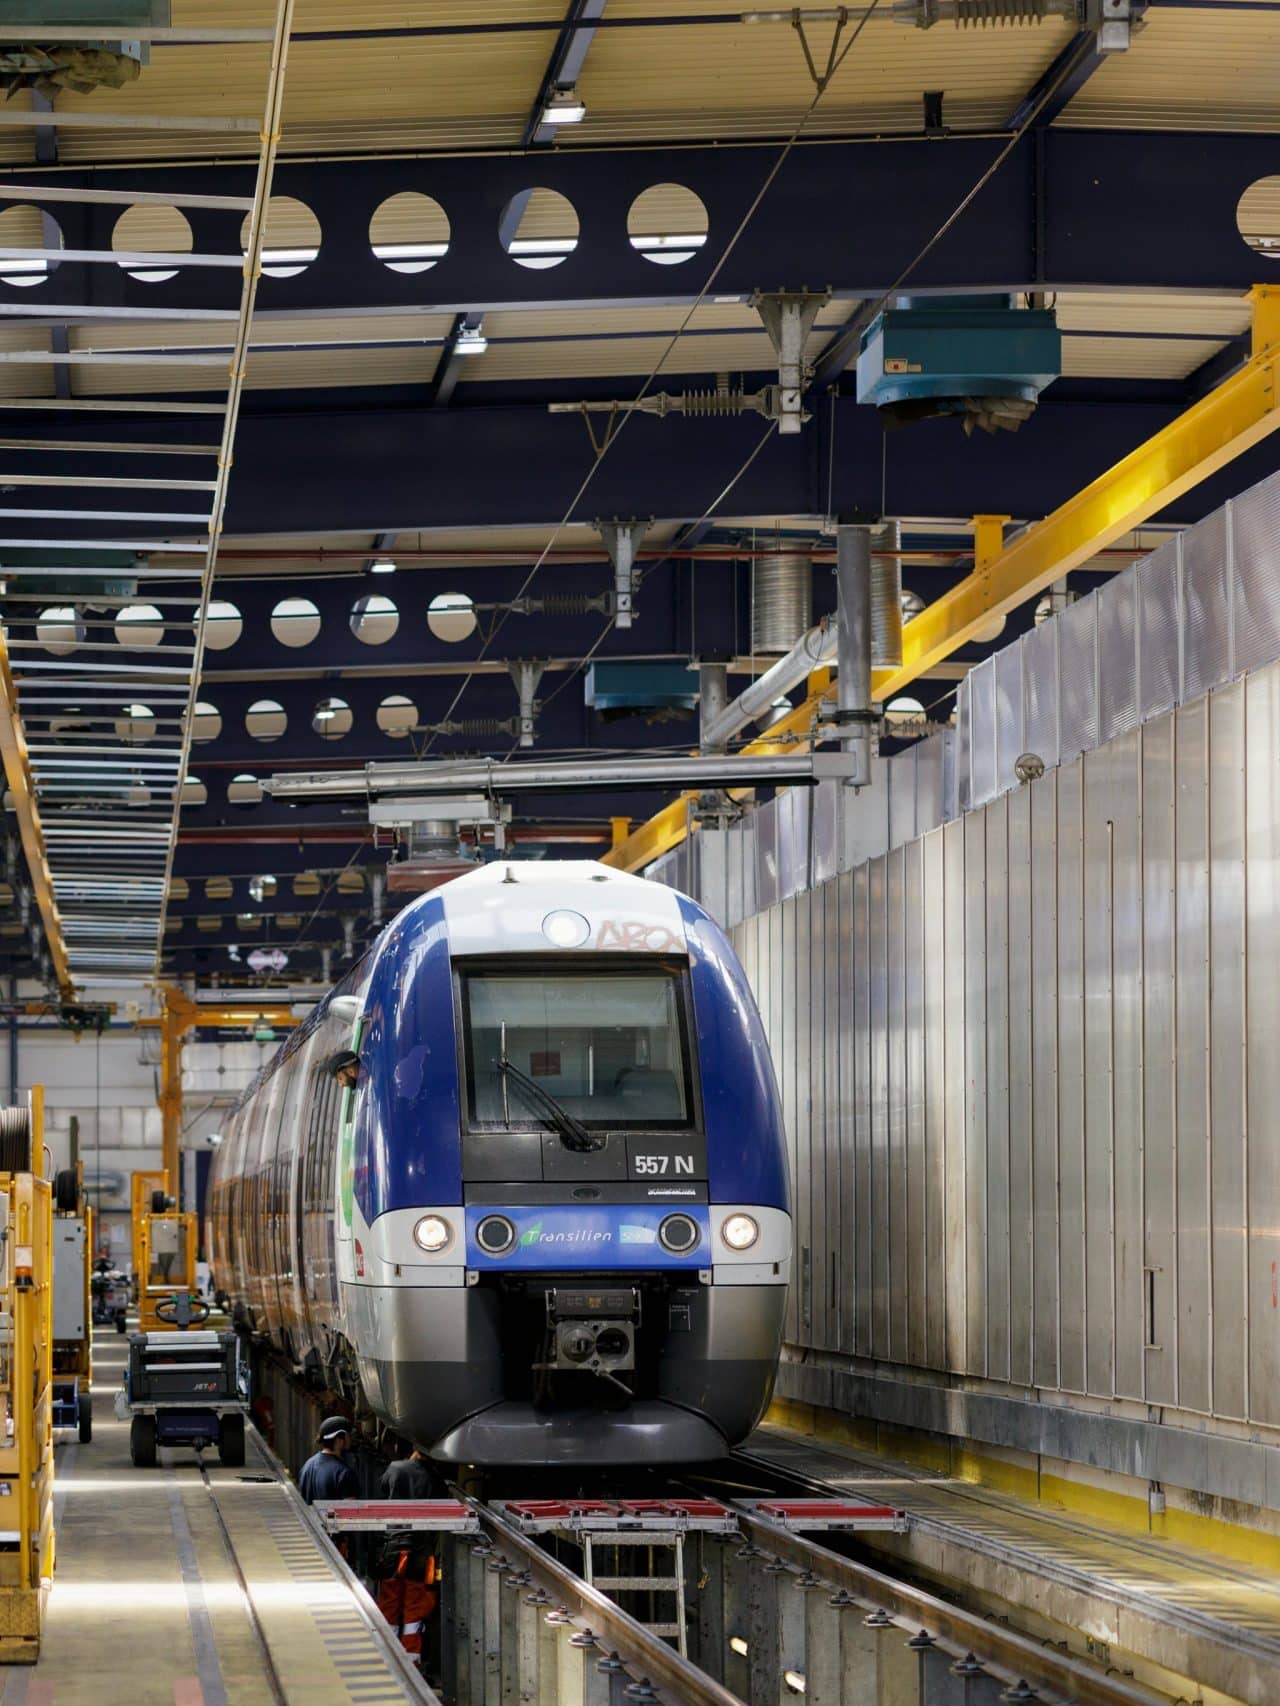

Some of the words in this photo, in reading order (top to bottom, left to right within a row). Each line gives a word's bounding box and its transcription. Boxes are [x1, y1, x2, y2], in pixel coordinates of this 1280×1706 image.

[635, 1155, 669, 1174] 557
[674, 1155, 695, 1174] N
[527, 1230, 612, 1242] Transilien
